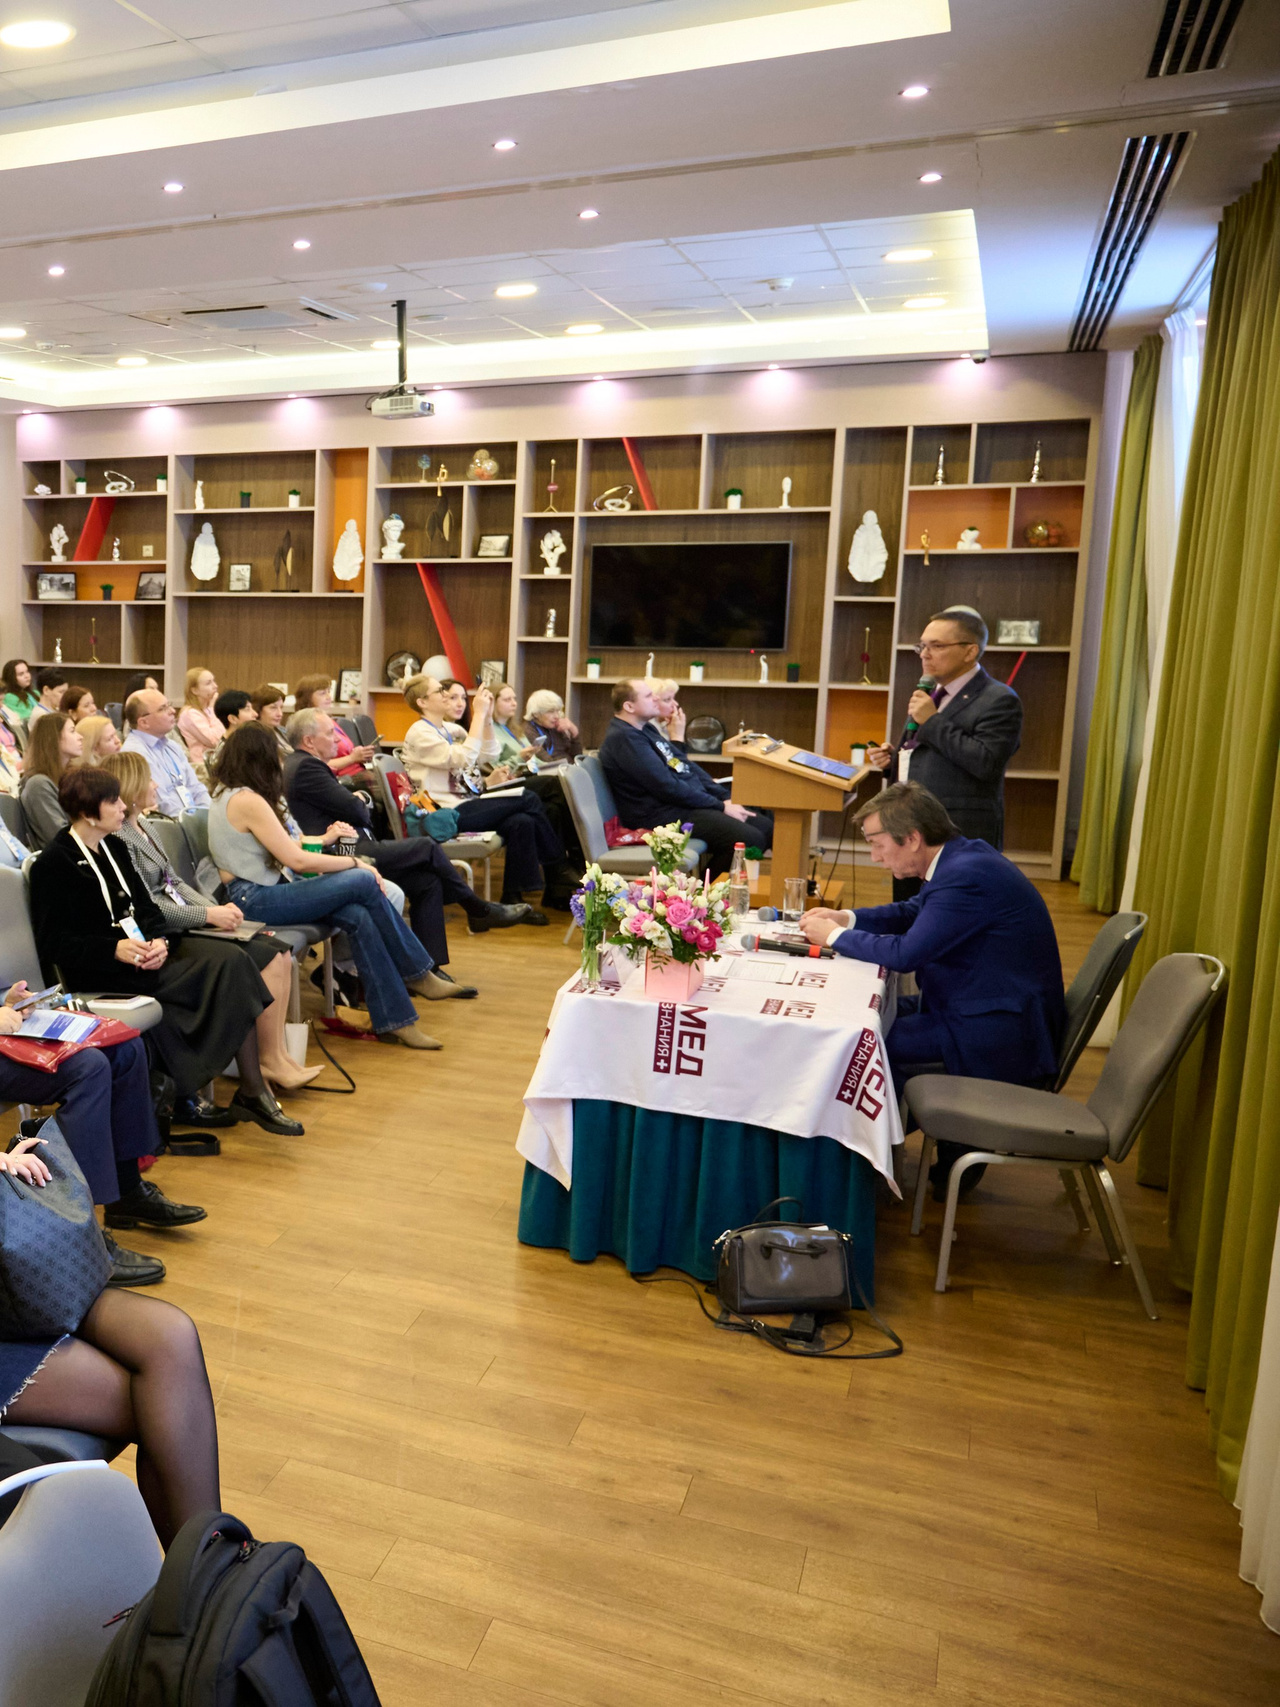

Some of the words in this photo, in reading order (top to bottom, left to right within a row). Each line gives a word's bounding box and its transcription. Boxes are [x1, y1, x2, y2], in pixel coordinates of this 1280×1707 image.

[798, 971, 829, 988] МЕД
[783, 1000, 817, 1019] МЕД
[675, 1003, 708, 1076] МЕД
[856, 1057, 887, 1122] ЕД
